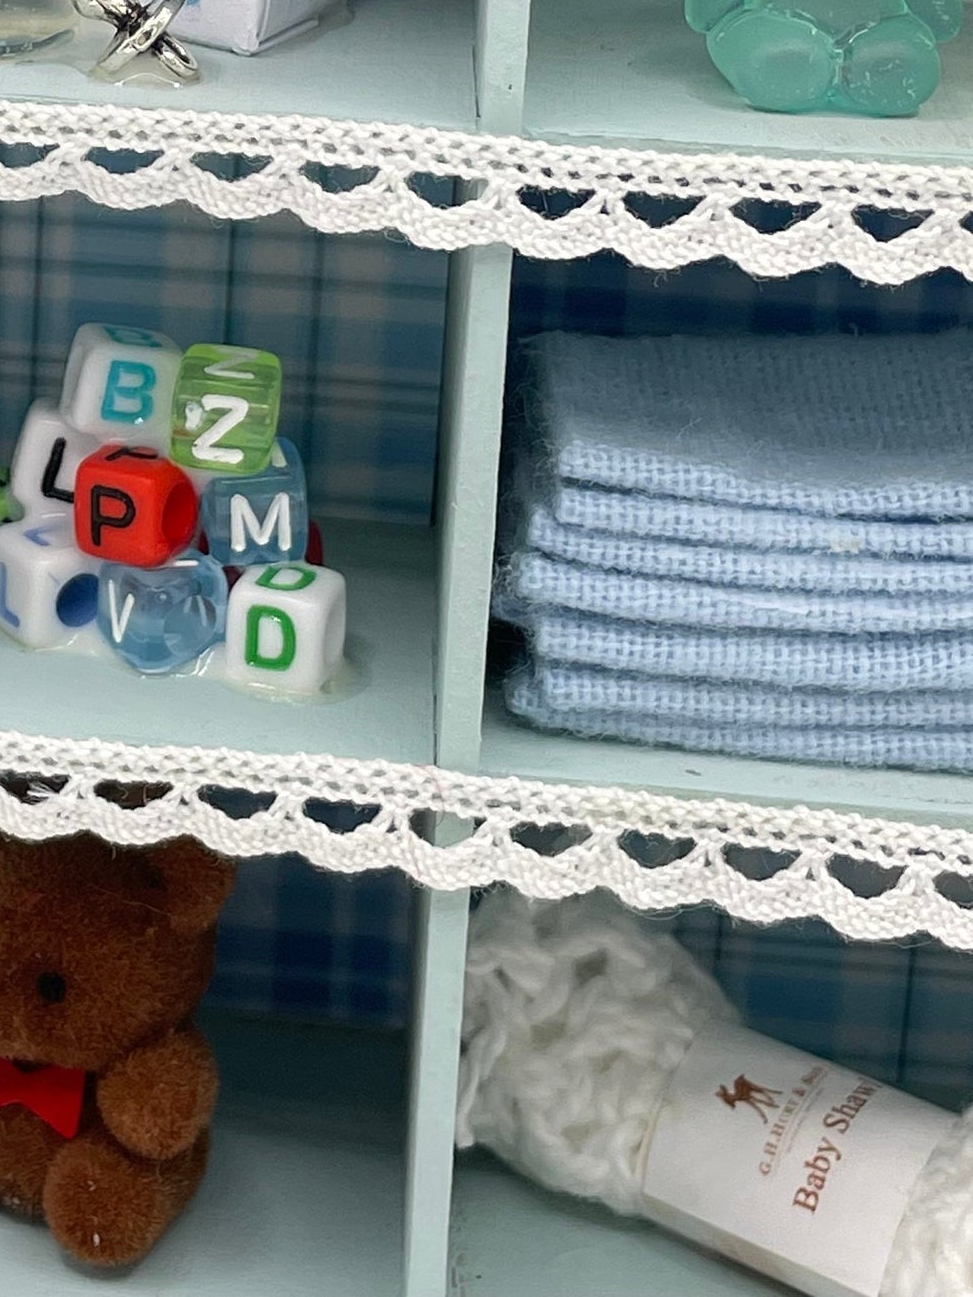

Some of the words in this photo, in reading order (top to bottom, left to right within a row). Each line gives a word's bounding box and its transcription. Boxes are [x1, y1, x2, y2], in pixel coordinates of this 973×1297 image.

[101, 359, 156, 423] B
[191, 393, 249, 465] Z
[41, 437, 75, 504] L
[89, 484, 137, 547] P
[231, 492, 292, 552] M
[108, 579, 136, 644] V
[244, 605, 297, 672] D
[793, 1137, 842, 1212] Baby
